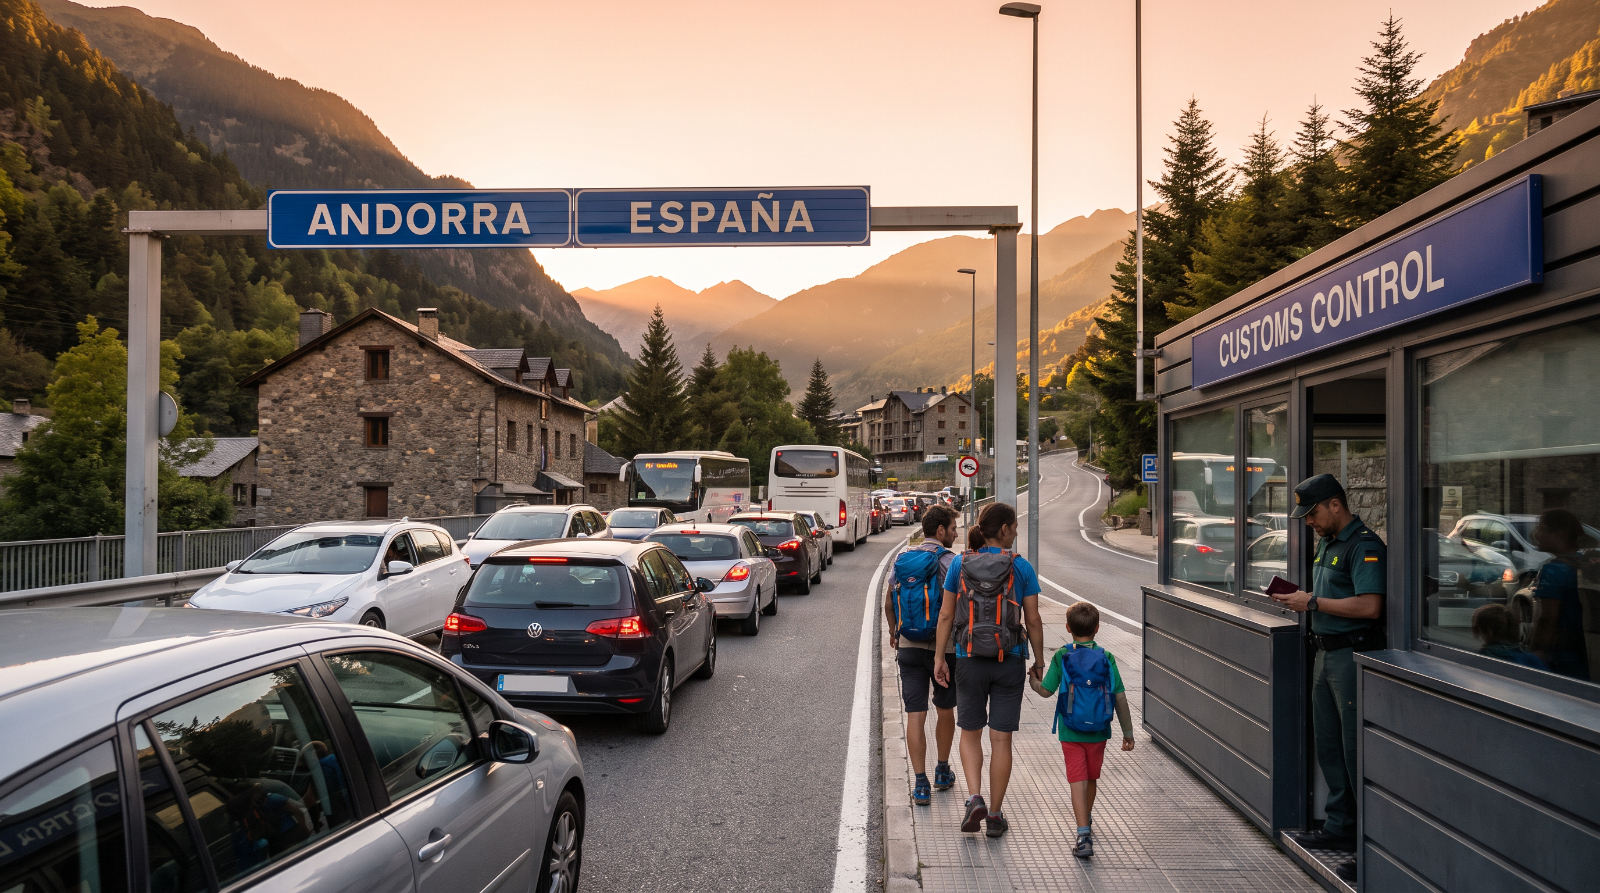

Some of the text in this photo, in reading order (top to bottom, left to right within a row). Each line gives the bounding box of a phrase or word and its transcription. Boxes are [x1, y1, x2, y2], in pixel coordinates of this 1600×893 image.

[307, 202, 531, 235] ANDORRA
[630, 192, 815, 234] ESPAÑA
[1219, 244, 1445, 367] CUSTOMS CONTROL
[1145, 458, 1154, 470] P
